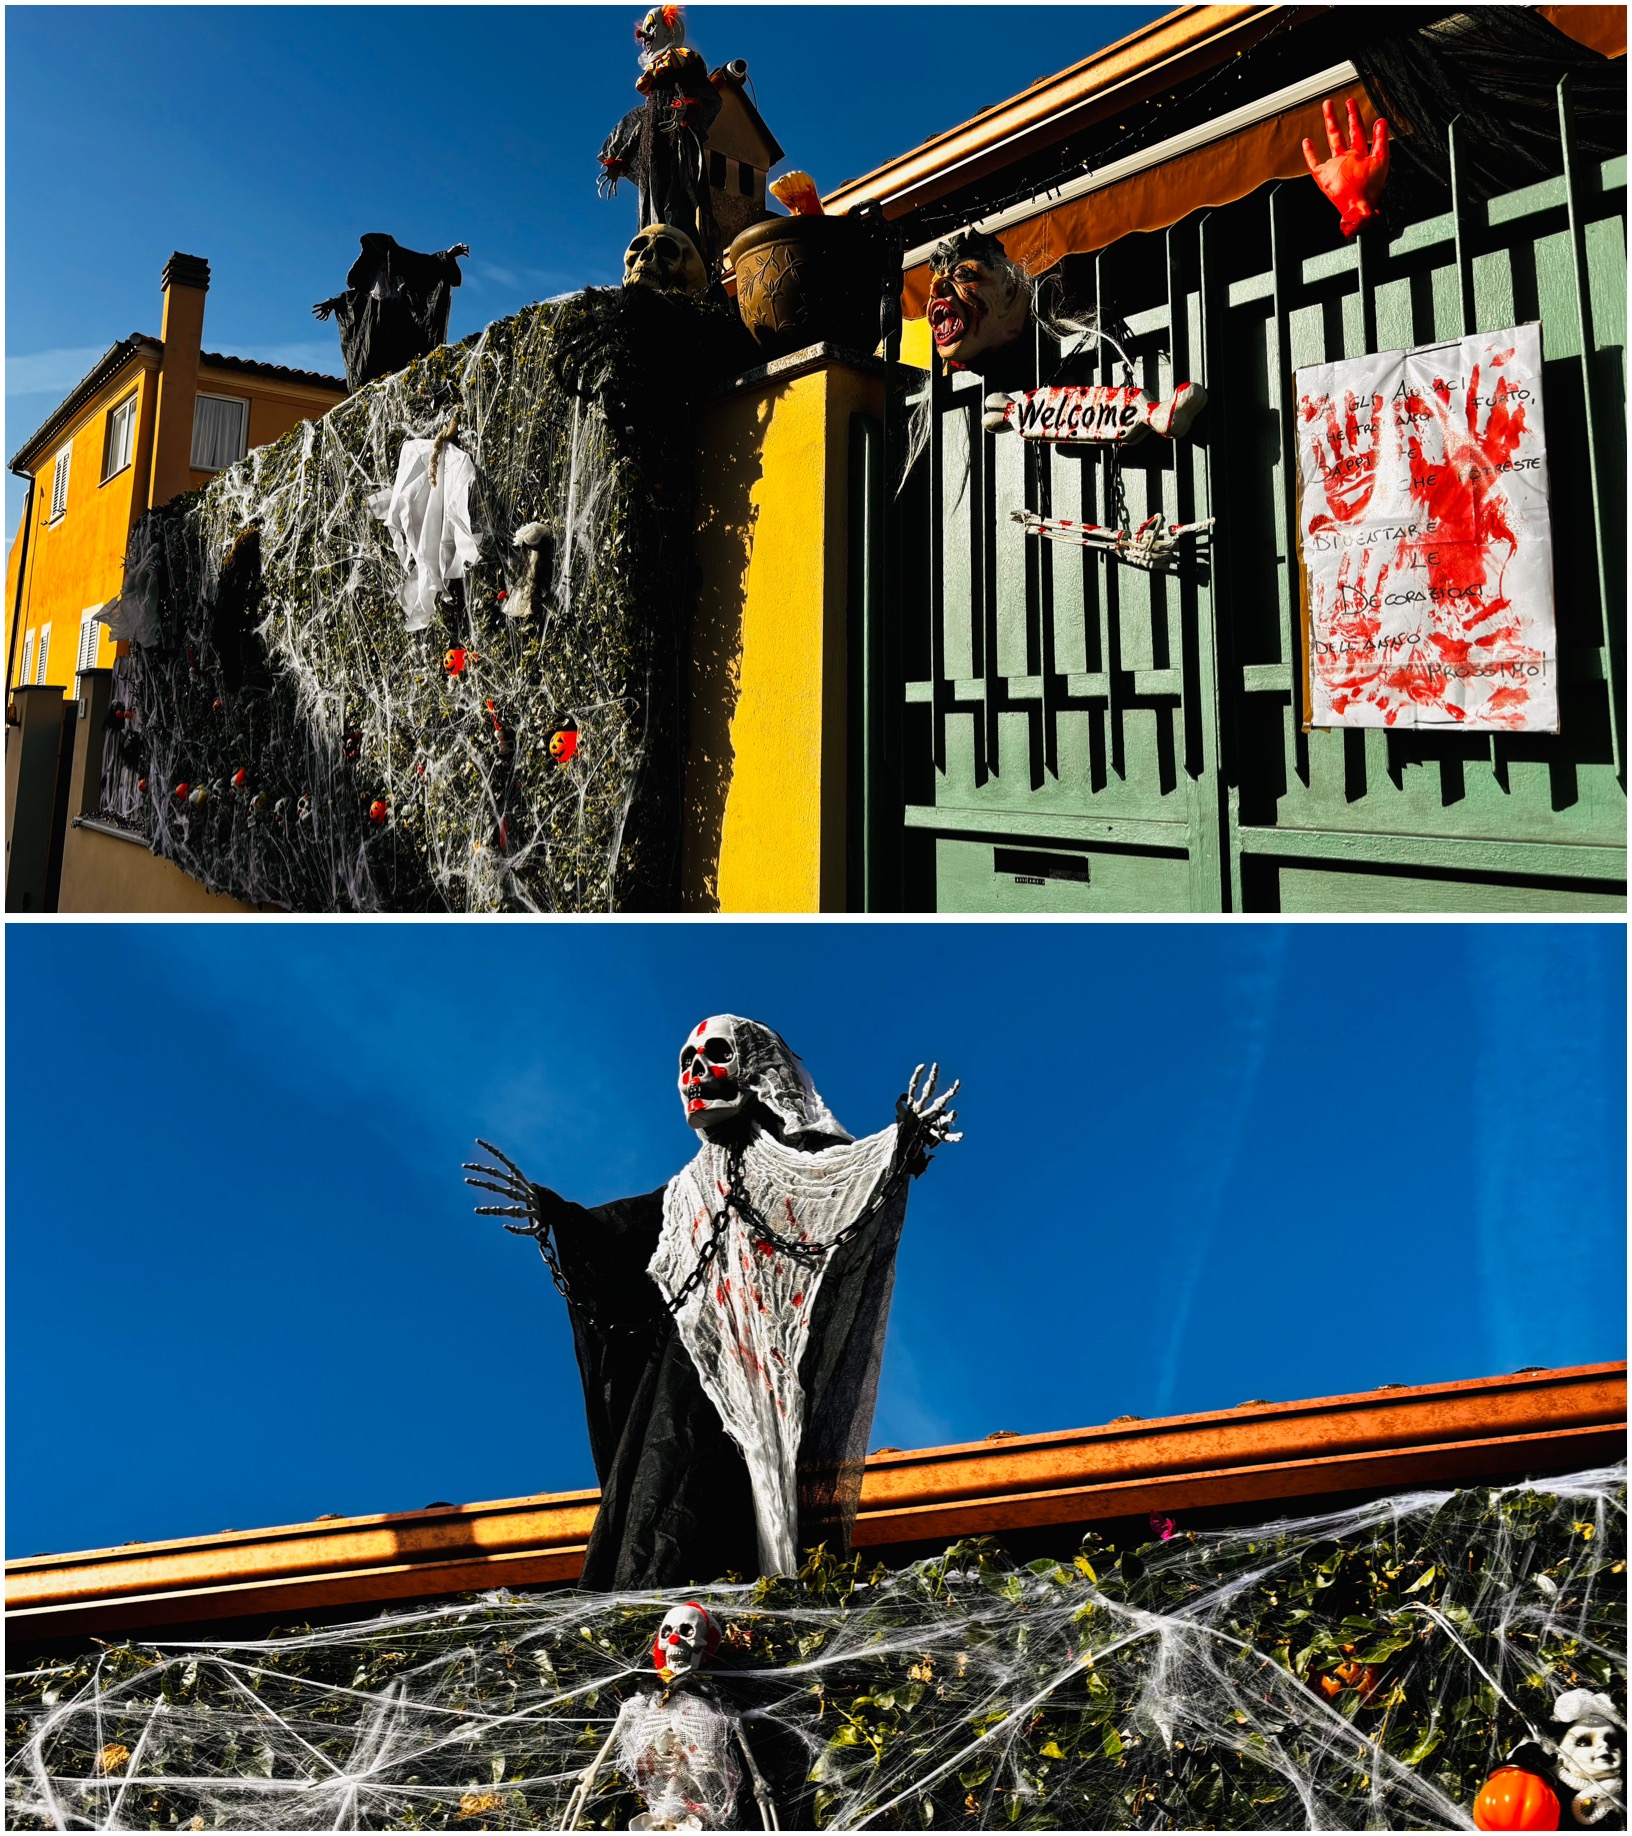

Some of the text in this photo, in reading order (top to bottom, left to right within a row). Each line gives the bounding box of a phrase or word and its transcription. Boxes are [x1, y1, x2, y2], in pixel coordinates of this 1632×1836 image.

[1018, 396, 1138, 429] Welcome
[1349, 391, 1377, 412] GLI
[1351, 411, 1431, 436] TRAANO
[1308, 448, 1419, 483] SAPPIE
[1410, 552, 1441, 569] LE
[1428, 651, 1546, 685] PROSSIMO!
